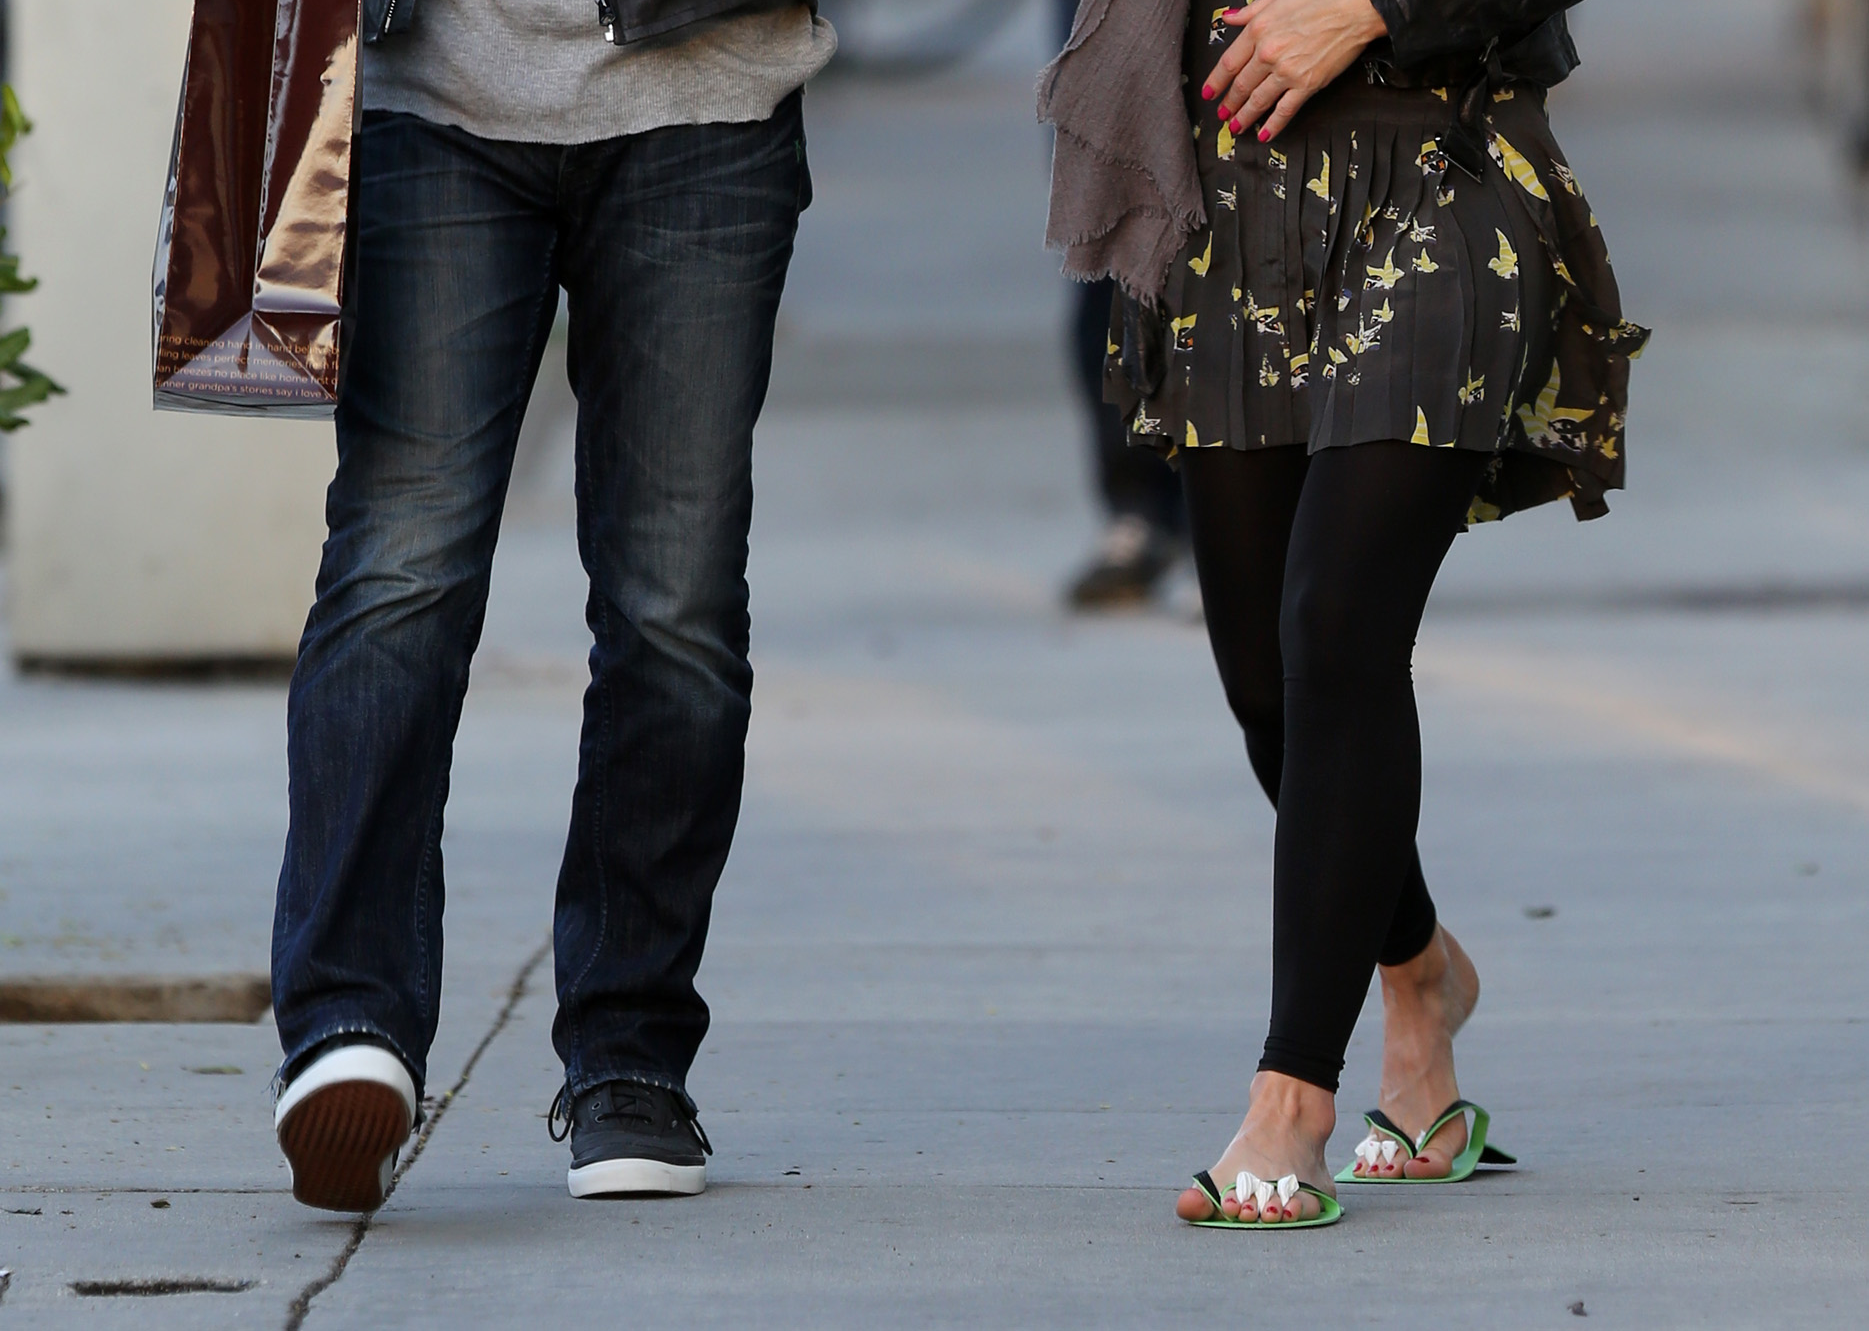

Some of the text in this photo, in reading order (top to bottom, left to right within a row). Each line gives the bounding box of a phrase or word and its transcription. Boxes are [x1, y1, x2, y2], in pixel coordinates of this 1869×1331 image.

[184, 336, 224, 349] cleaning
[227, 339, 252, 349] hand
[255, 341, 265, 350] in
[267, 342, 292, 353] hand
[182, 350, 211, 361] leaves
[214, 353, 250, 365] perfect
[253, 357, 302, 368] memories
[174, 365, 212, 377] breezes
[215, 369, 227, 377] no
[230, 370, 257, 380] place
[260, 372, 276, 382] like
[279, 373, 308, 383] home
[310, 375, 328, 385] first
[188, 381, 237, 392] grandpa's
[240, 385, 273, 395] stories
[276, 388, 292, 398] say
[301, 389, 321, 398] love
